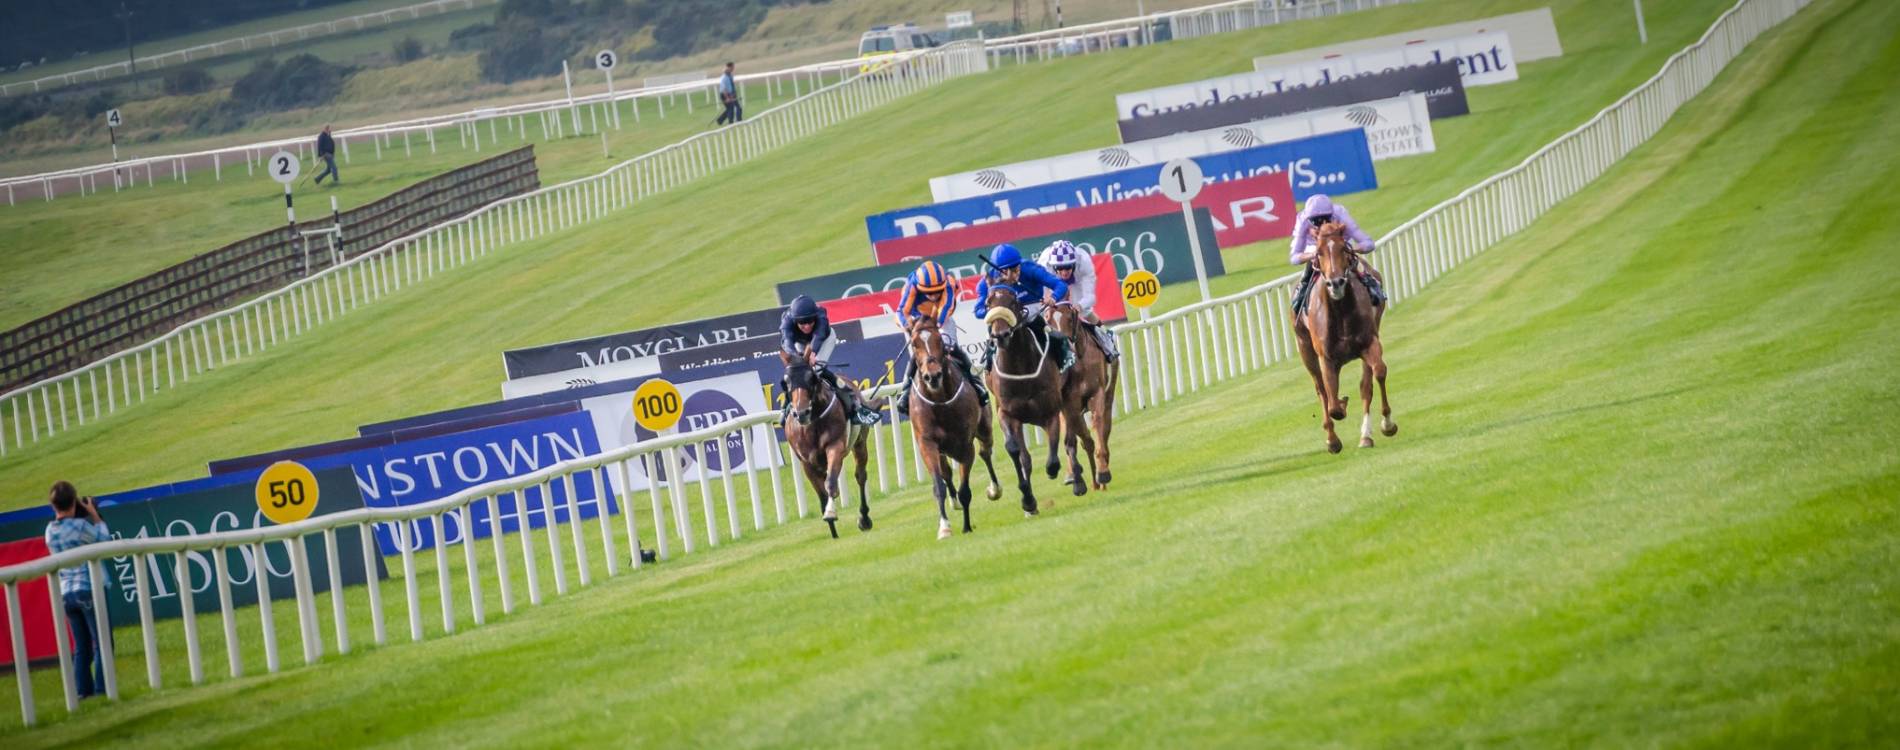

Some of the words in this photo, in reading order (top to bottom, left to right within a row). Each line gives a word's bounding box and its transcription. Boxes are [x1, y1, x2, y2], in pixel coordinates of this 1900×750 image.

[600, 53, 613, 67] 3
[109, 111, 119, 124] 4
[1374, 136, 1423, 154] ESTATE
[277, 157, 290, 174] 2
[1171, 166, 1187, 193] 1
[1125, 279, 1157, 299] 200
[637, 392, 678, 419] 100
[269, 479, 305, 508] 50
